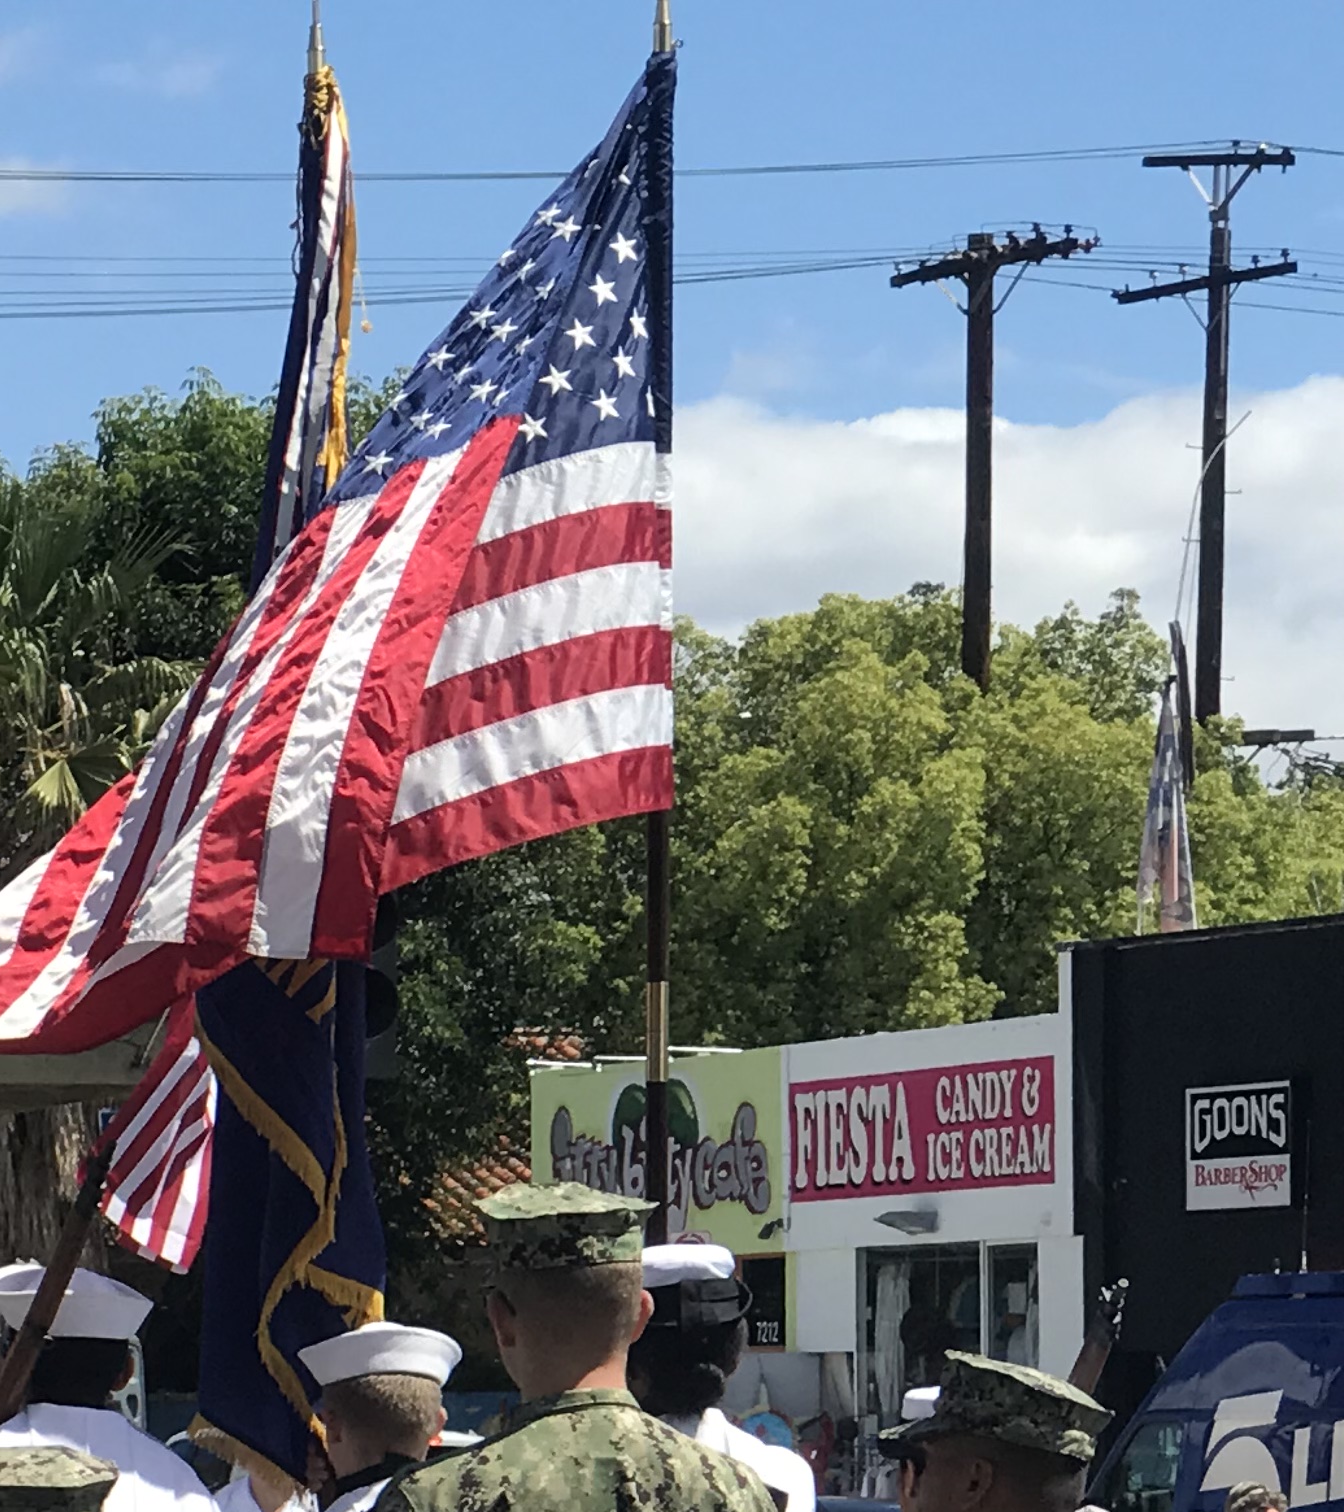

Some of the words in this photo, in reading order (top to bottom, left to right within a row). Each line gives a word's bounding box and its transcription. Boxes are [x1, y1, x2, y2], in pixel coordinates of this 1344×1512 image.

[936, 1069, 1017, 1124] CANDY
[1022, 1066, 1041, 1117] &
[1194, 1094, 1286, 1153] GOONS
[795, 1081, 915, 1189] FIESTA
[926, 1130, 964, 1181] ICE
[969, 1123, 1051, 1177] CREAM
